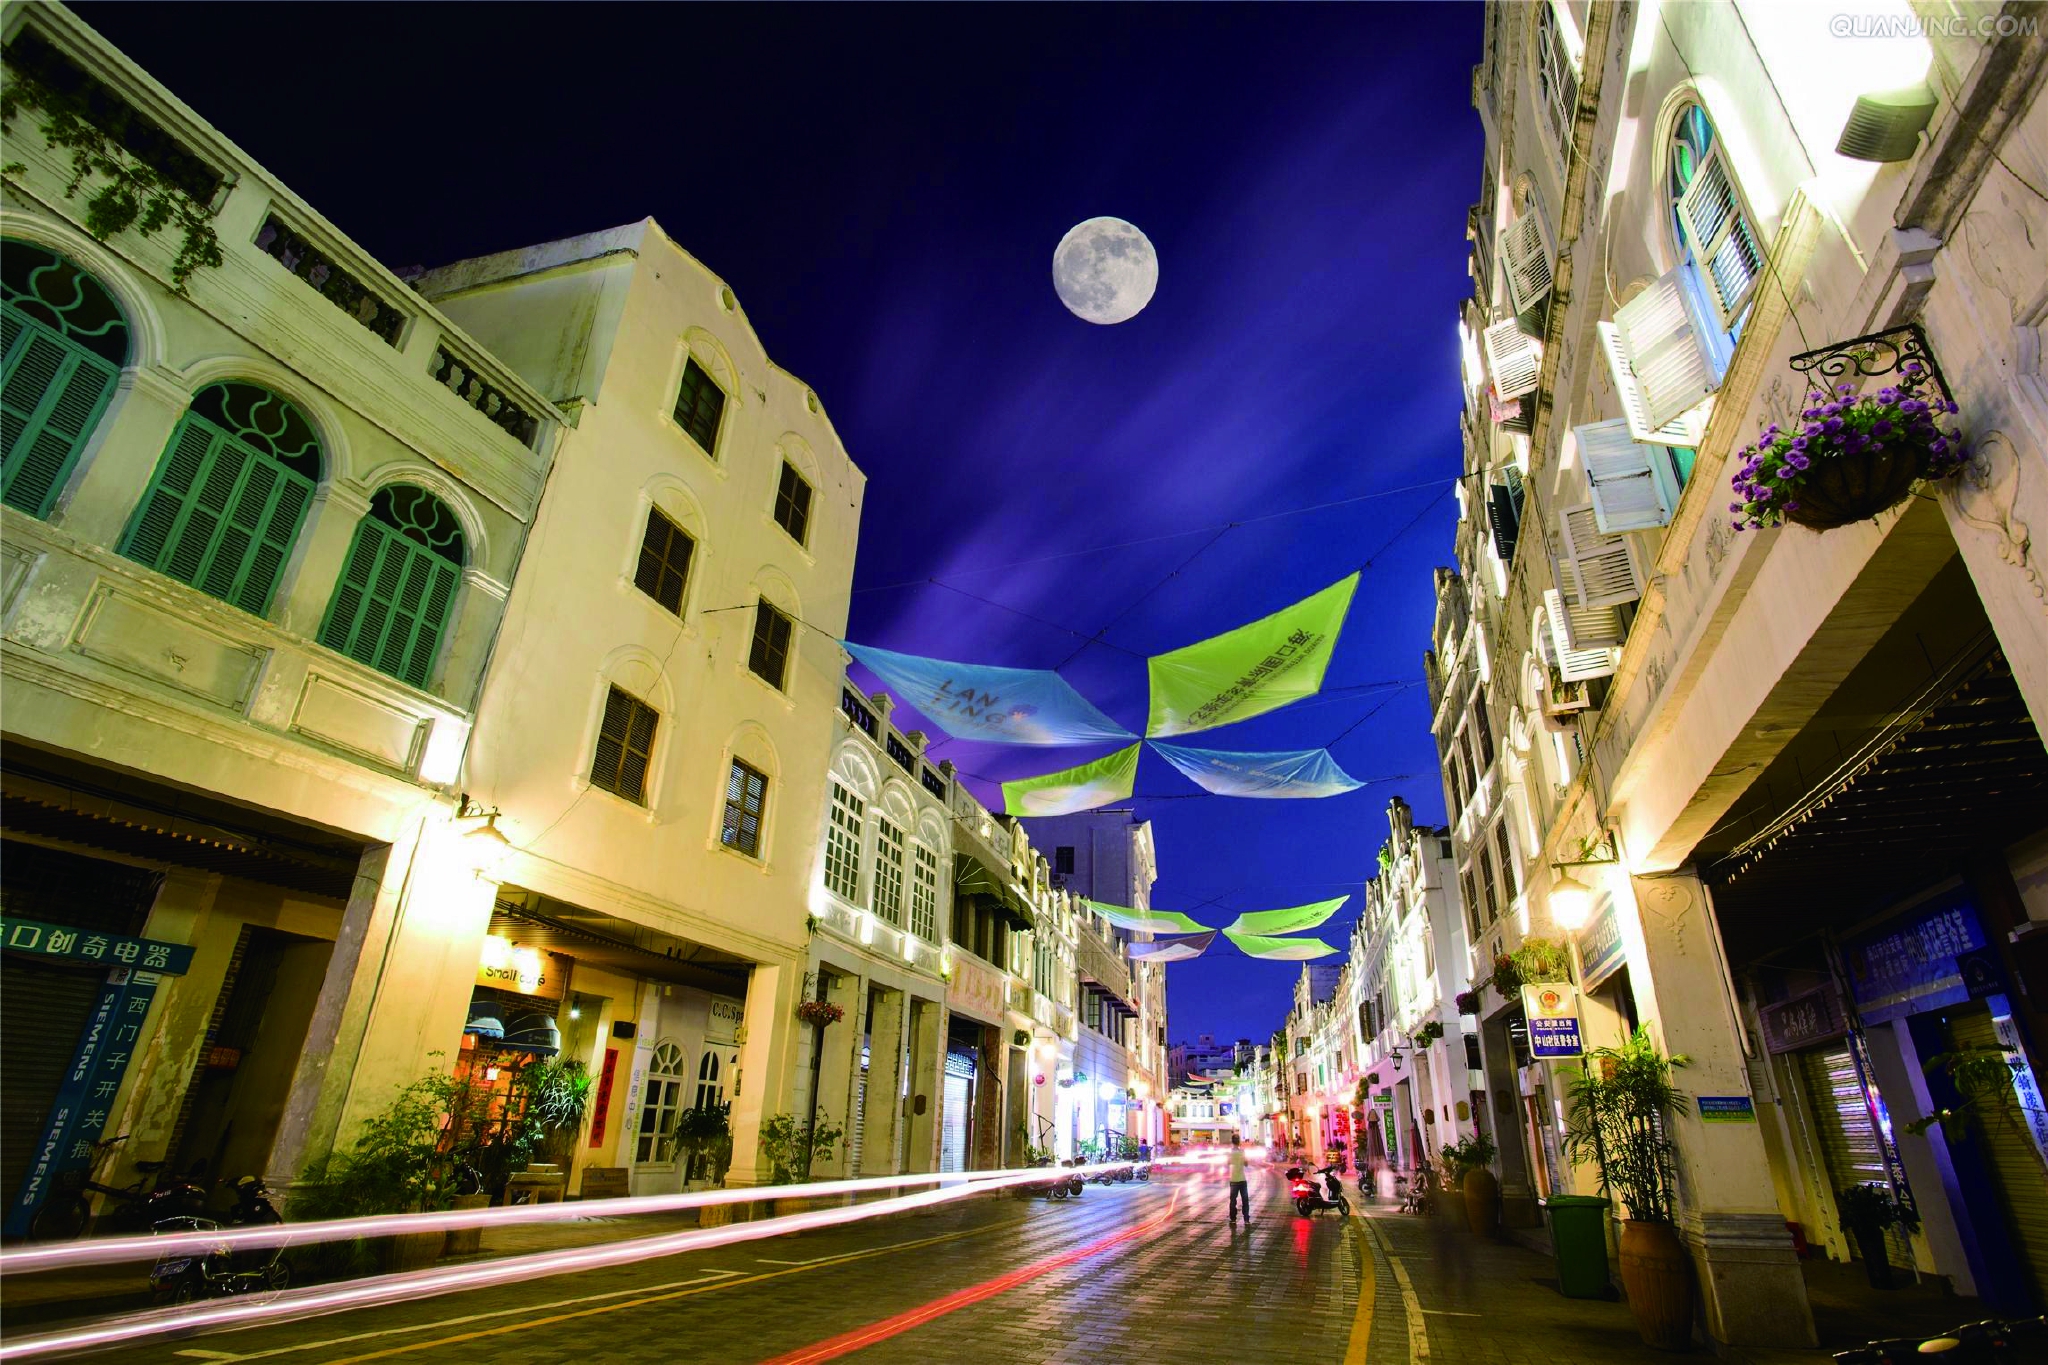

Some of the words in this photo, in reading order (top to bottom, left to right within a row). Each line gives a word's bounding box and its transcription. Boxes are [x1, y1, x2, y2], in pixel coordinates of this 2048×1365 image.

[939, 678, 1000, 708] LAN
[0, 923, 171, 968] 口创奇电器
[486, 965, 518, 982] Small
[73, 993, 115, 1082] SIEMENS
[1534, 1034, 1580, 1047] 中山社区警务室
[23, 1107, 69, 1206] SIEMENS
